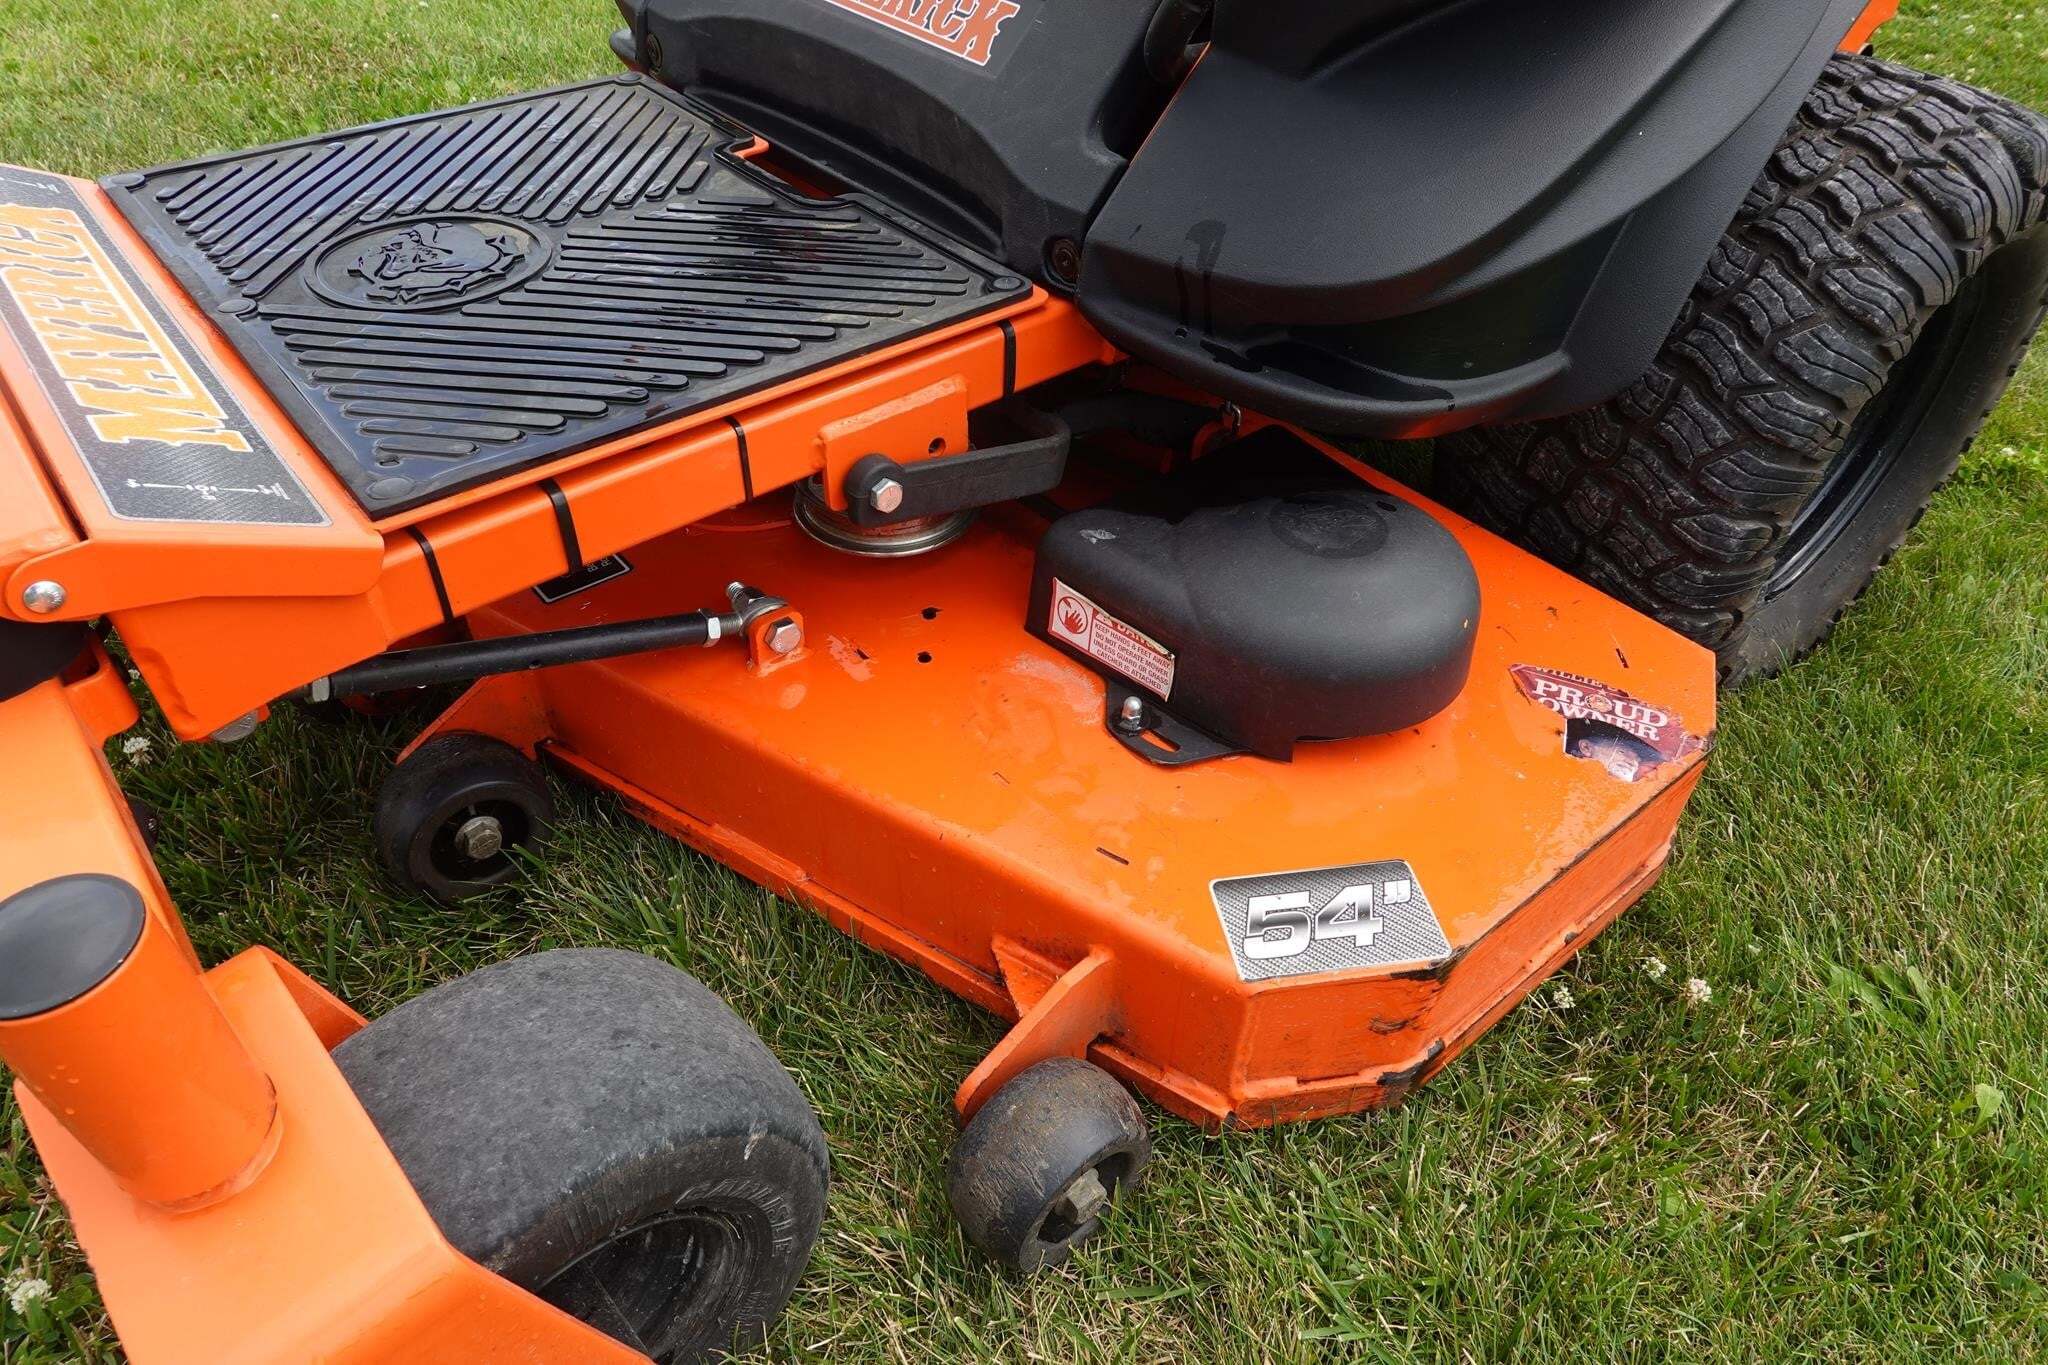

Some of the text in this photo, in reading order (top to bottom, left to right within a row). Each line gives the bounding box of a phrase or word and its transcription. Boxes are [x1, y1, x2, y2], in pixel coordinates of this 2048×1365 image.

[1094, 639, 1169, 686] UNLESS GUARD OR GRASS
[1095, 623, 1110, 633] KEEP
[1111, 631, 1131, 647] HANDS
[1137, 646, 1151, 659] FEET
[1095, 632, 1105, 641] DO
[1105, 637, 1117, 647] NOT
[1118, 645, 1145, 664] OPERATE
[1145, 660, 1169, 677] MOWER
[1096, 649, 1123, 669] CATCHER
[1123, 663, 1130, 673] IS
[1532, 677, 1668, 728] PROUD
[1537, 697, 1661, 741] OWNER
[1243, 879, 1412, 960] 54"
